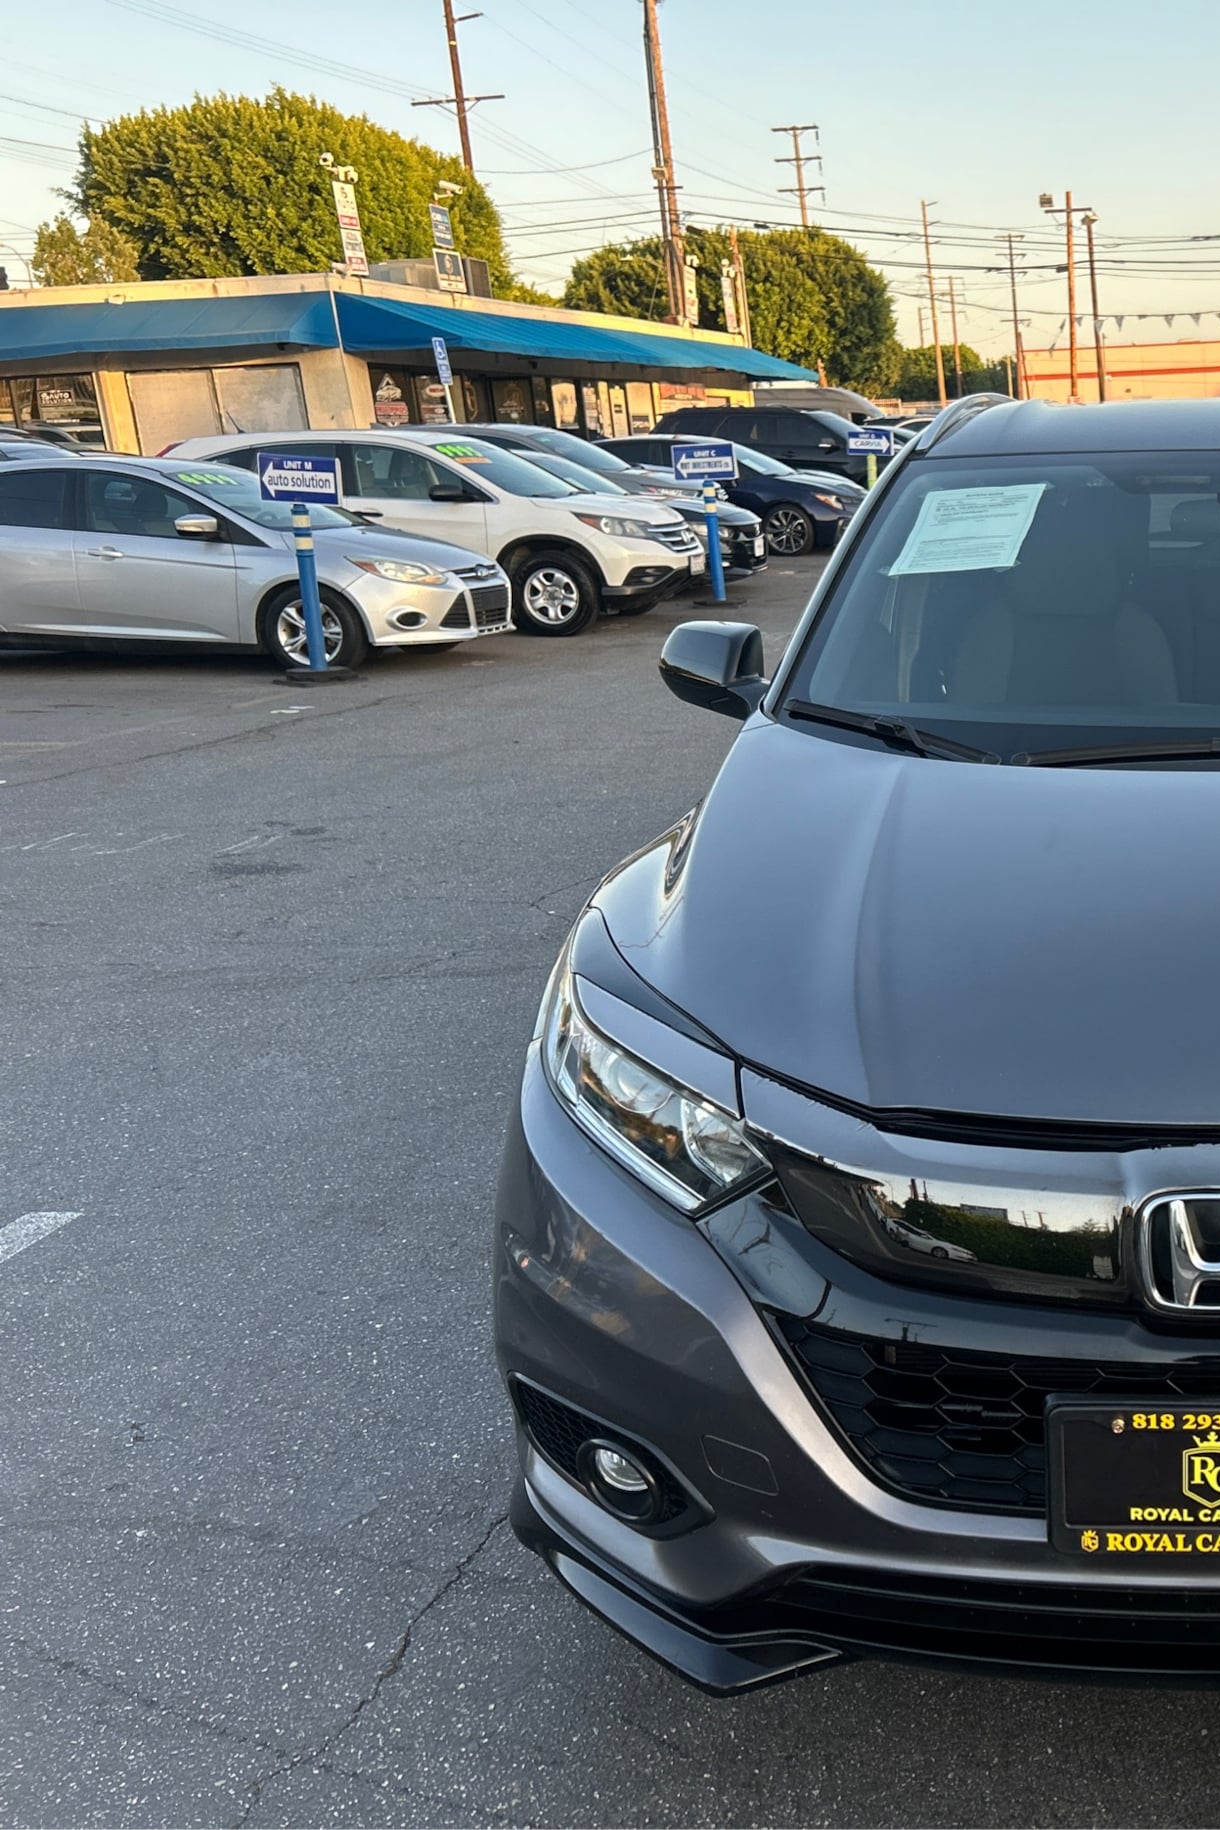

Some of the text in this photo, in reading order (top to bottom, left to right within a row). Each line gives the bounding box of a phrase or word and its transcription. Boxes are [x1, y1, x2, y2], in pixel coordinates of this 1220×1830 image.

[693, 449, 710, 458] UNIT
[283, 460, 312, 470] UNIT M
[268, 473, 331, 490] auto solution
[1131, 1413, 1176, 1430] 818
[1129, 1507, 1195, 1522] ROYAL
[1106, 1532, 1193, 1552] ROYAL
